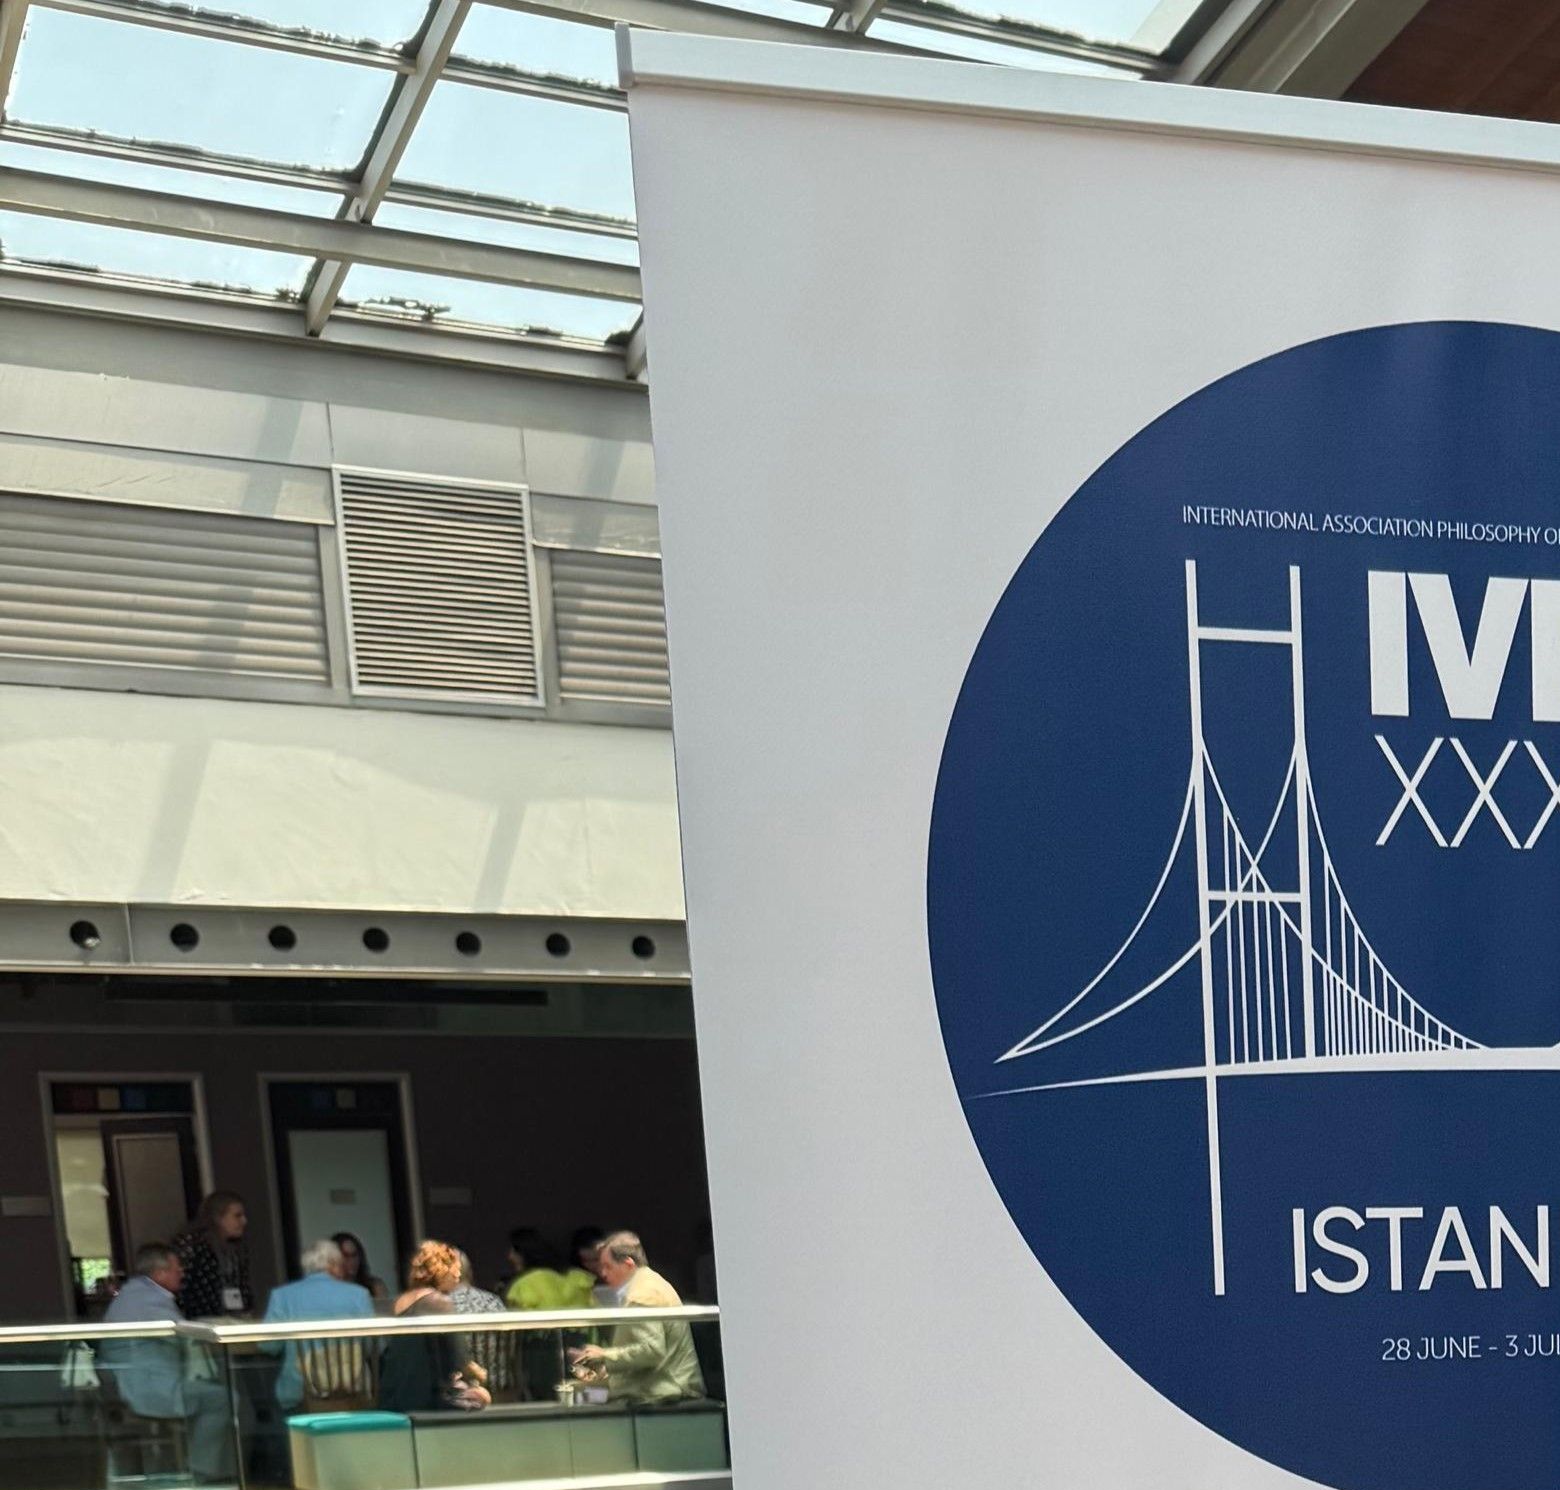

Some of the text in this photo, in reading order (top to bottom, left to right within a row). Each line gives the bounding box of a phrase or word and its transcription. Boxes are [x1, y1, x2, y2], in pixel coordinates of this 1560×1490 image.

[1183, 505, 1318, 531] INTERNATIONAL
[1322, 514, 1433, 538] ASSOCIATION
[1437, 521, 1541, 544] PHILOSOPHY
[1382, 1338, 1411, 1361] 28
[1416, 1336, 1482, 1359] JUNE
[1505, 1334, 1519, 1357] 3
